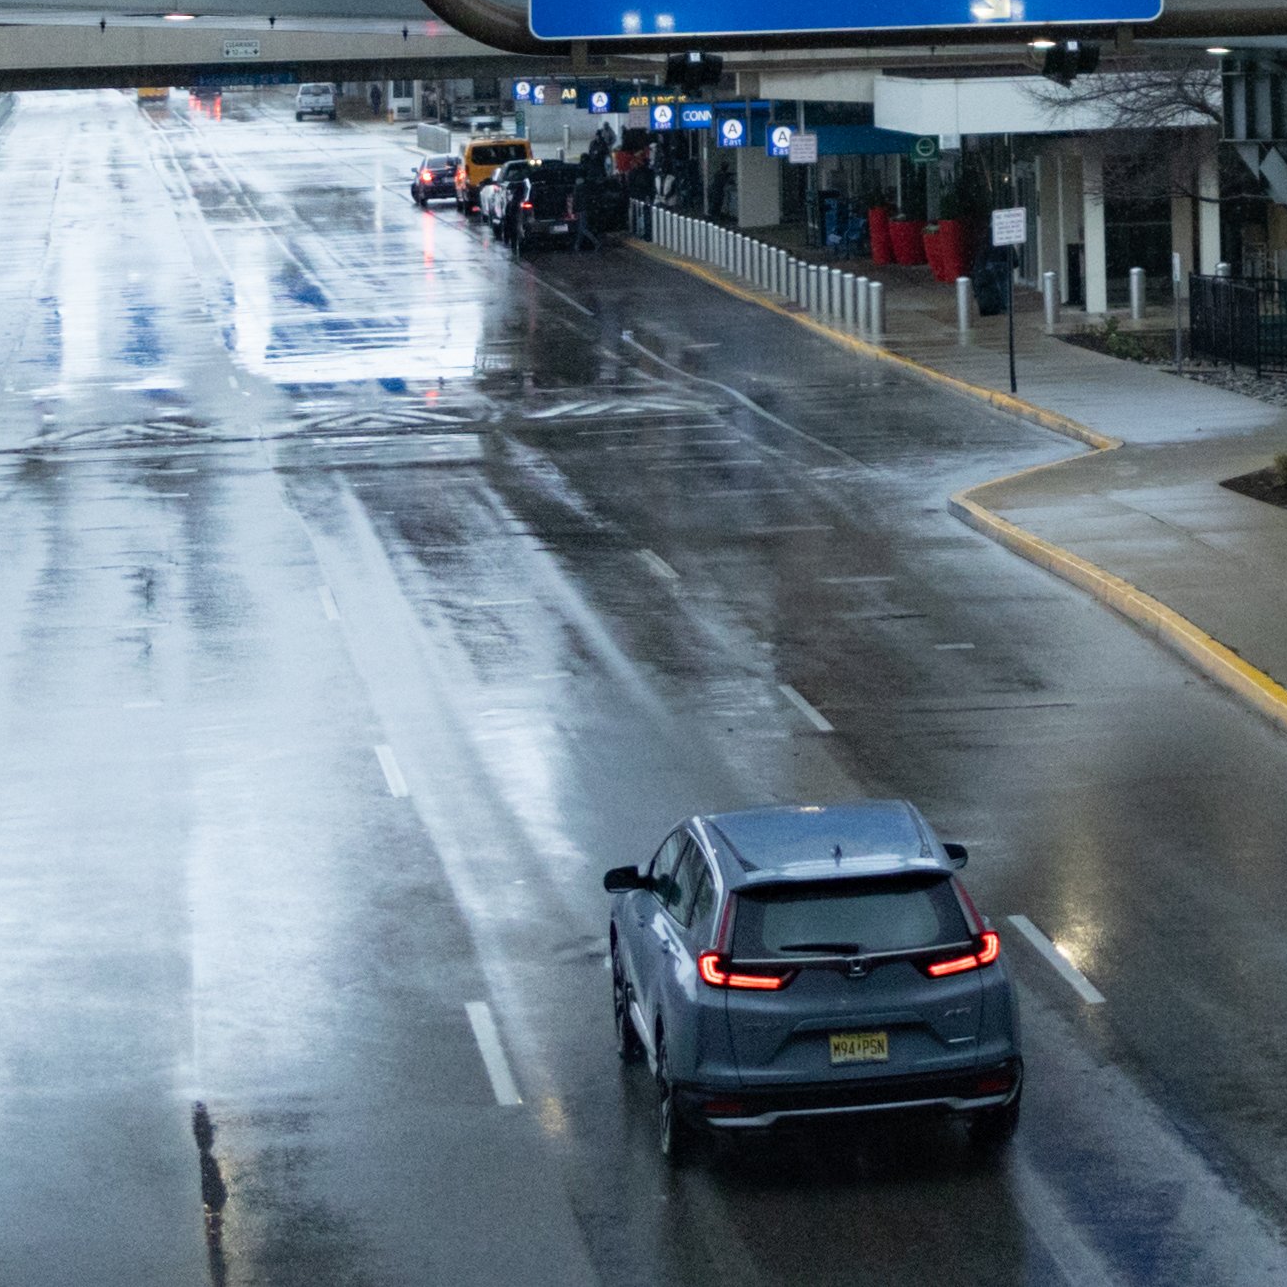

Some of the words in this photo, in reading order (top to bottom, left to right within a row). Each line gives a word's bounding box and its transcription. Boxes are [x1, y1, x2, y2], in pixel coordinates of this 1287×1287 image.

[727, 122, 738, 134] A
[777, 130, 788, 142] A
[723, 137, 742, 147] East
[772, 147, 790, 156] Eas
